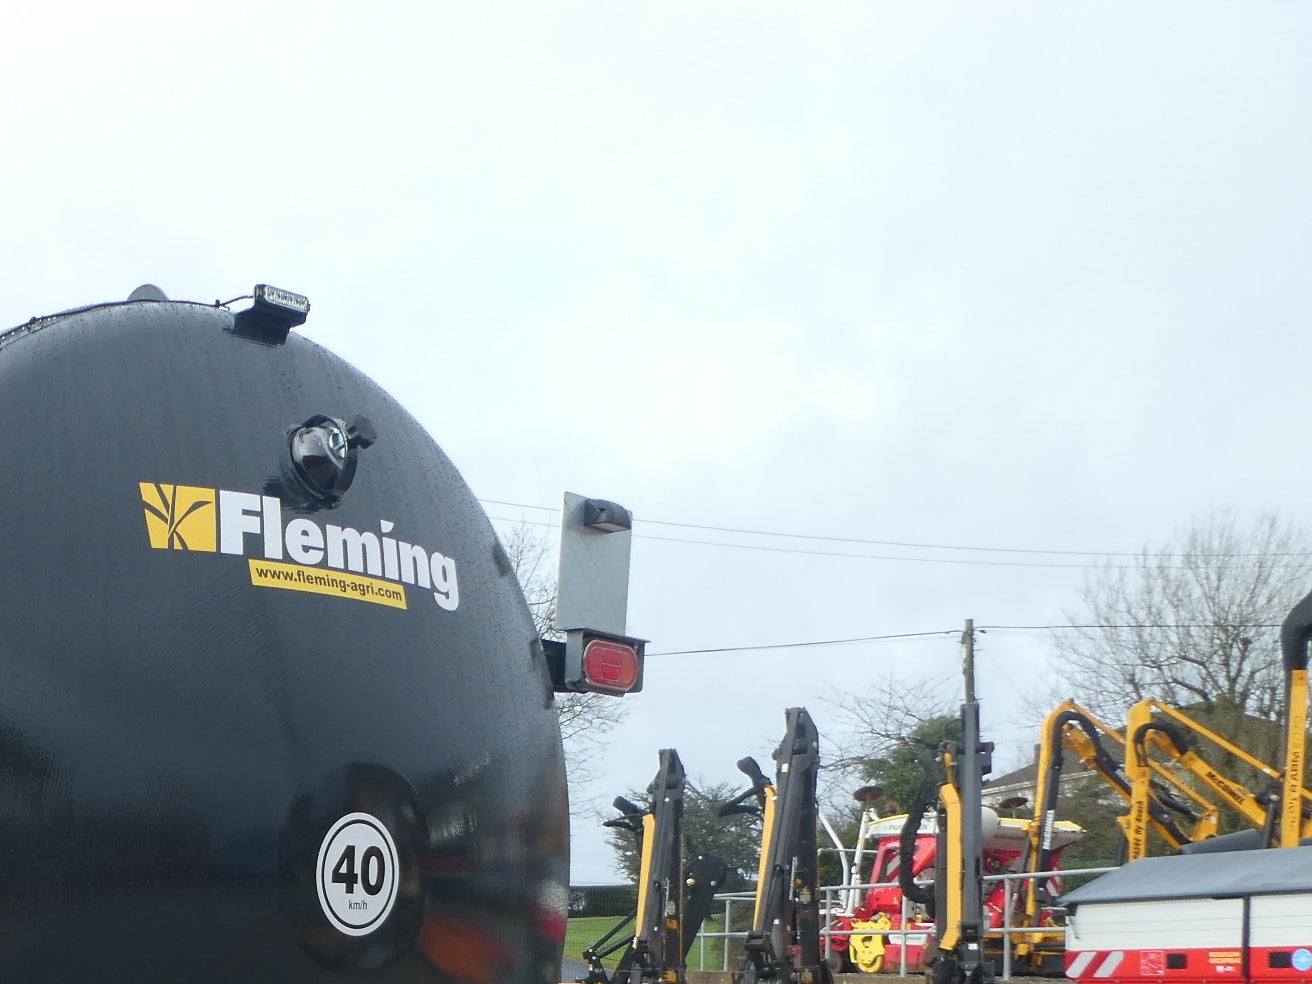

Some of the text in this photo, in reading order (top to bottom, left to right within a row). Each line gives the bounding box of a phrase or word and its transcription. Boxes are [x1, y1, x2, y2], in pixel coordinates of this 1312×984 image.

[220, 489, 459, 611] Fleming
[255, 566, 403, 602] www.fleming-agri.com
[331, 844, 386, 896] 40
[348, 899, 368, 911] km/h
